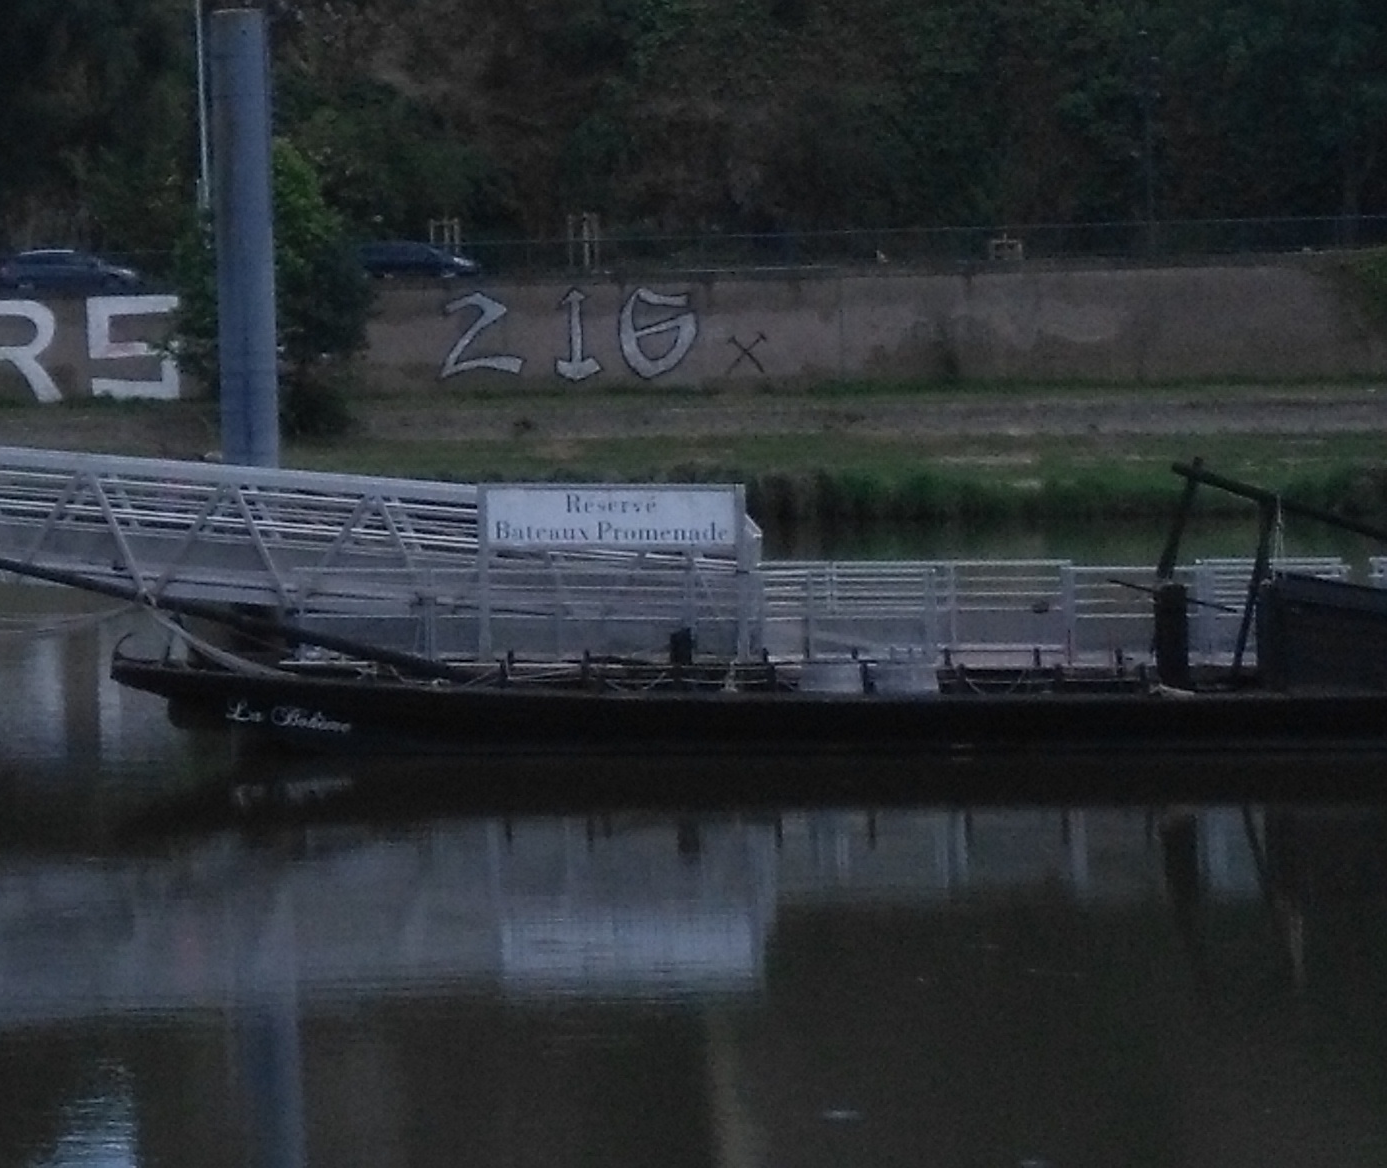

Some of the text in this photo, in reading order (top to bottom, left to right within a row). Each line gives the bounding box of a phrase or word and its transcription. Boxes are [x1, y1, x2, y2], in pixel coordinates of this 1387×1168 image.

[438, 286, 701, 380] 216
[495, 521, 728, 542] Bateaux Promenade
